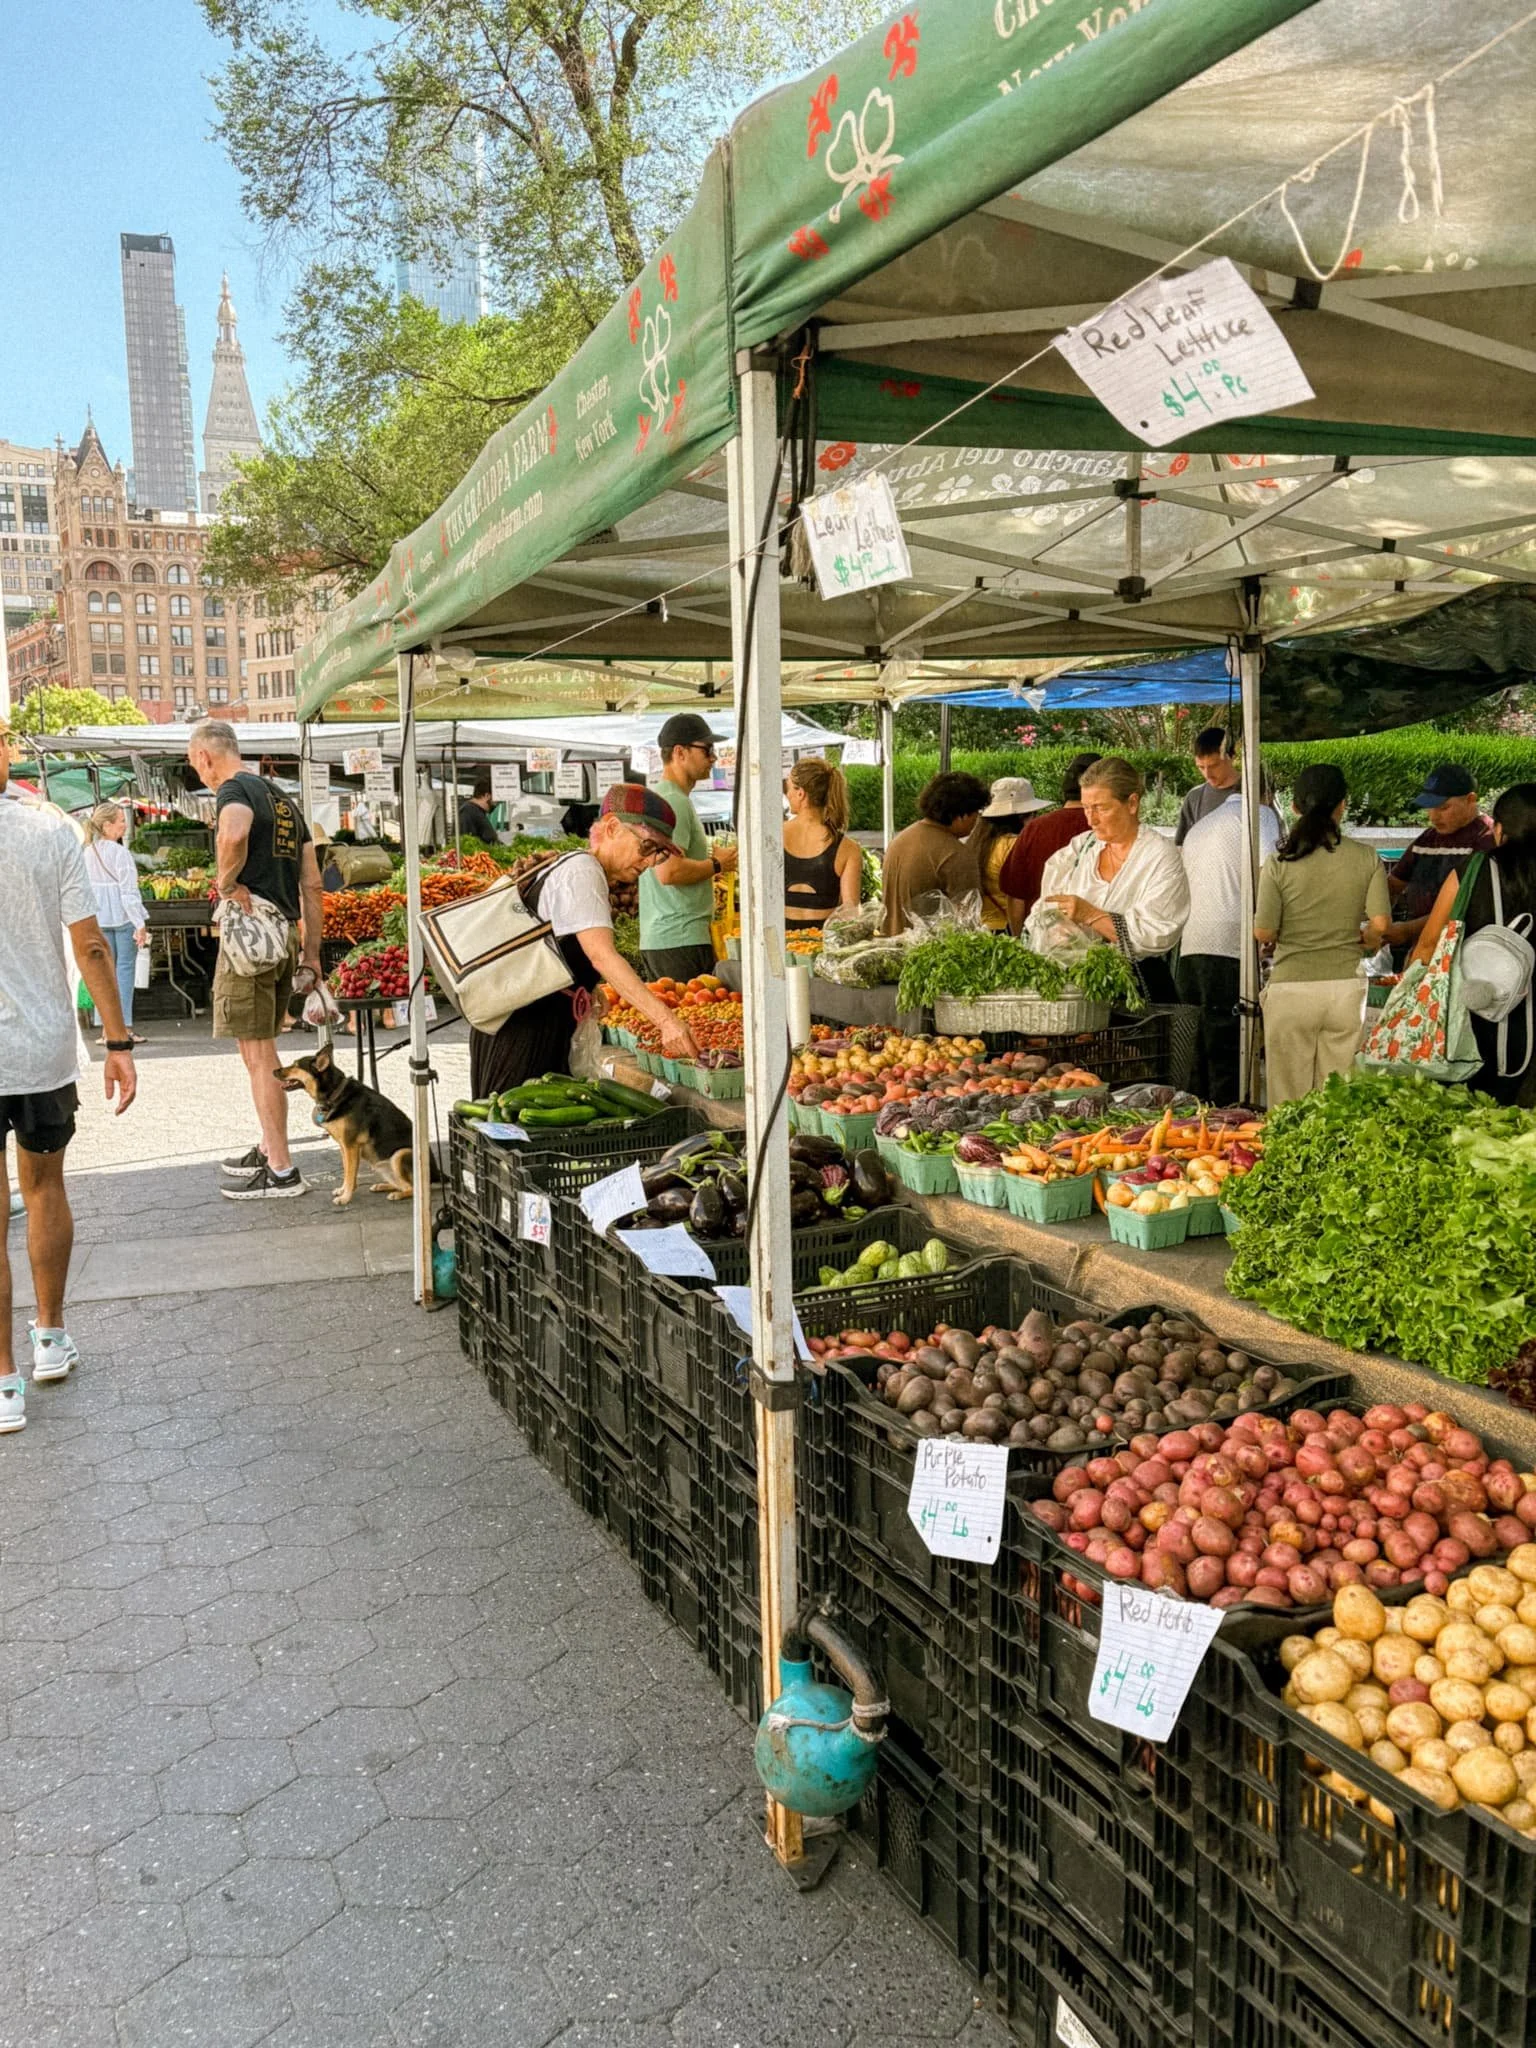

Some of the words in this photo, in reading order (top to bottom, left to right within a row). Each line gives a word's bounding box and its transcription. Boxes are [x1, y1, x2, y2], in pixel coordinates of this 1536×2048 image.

[1081, 309, 1146, 359] Red
[1154, 318, 1255, 367] Lettuce
[512, 412, 549, 481] FARM
[592, 409, 618, 447] York
[1119, 1587, 1153, 1623] Red
